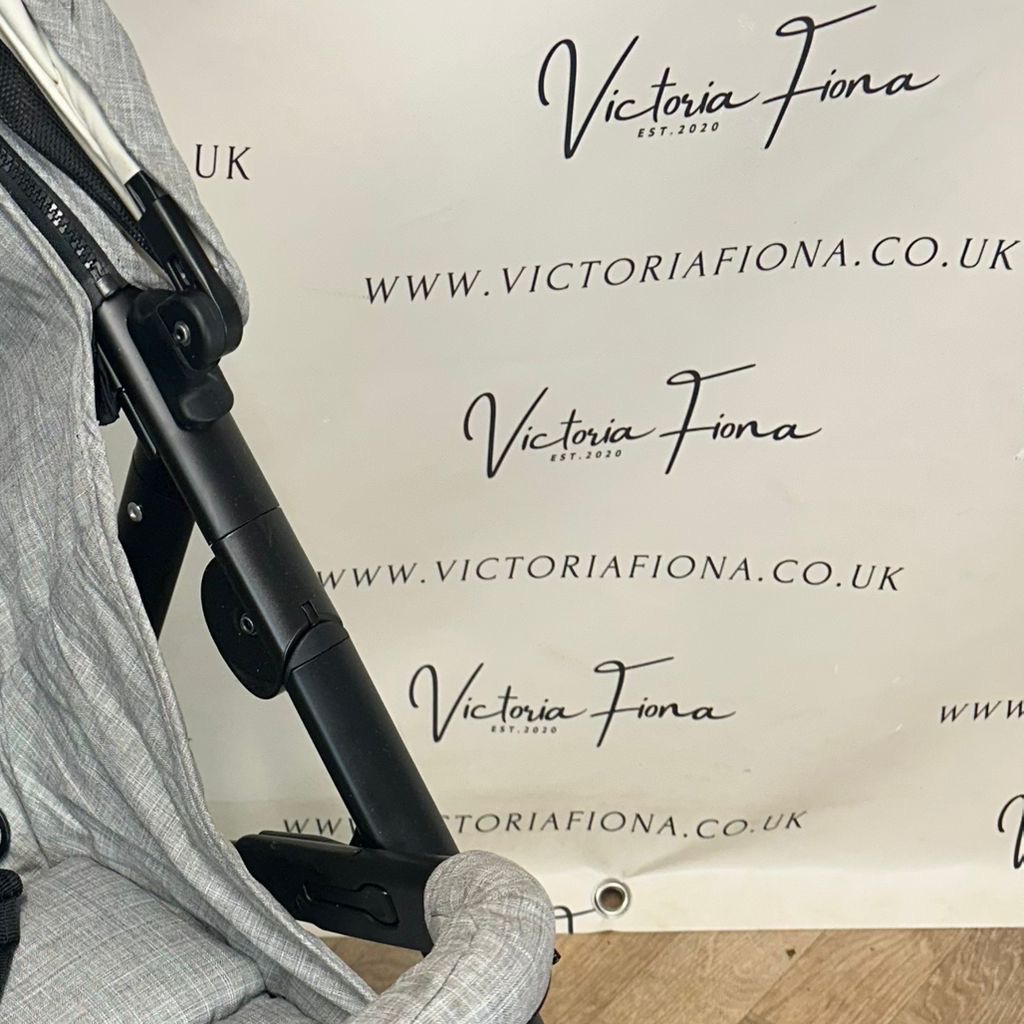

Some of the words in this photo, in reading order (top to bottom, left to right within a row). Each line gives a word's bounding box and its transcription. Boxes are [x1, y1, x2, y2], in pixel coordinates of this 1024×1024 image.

[537, 34, 761, 160] Victoria
[762, 5, 941, 151] Fiona
[636, 121, 720, 139] EST.2020
[364, 235, 1023, 305] WWW.VICTORIAFIONA.CO.UK
[462, 386, 657, 480] Victoria
[657, 363, 823, 476] Fiona
[549, 449, 622, 463] EST.2020
[317, 554, 906, 592] WWW.VICTORIAFIONA.CO.UK
[408, 661, 589, 744] Victoria
[589, 655, 737, 749] Fiona
